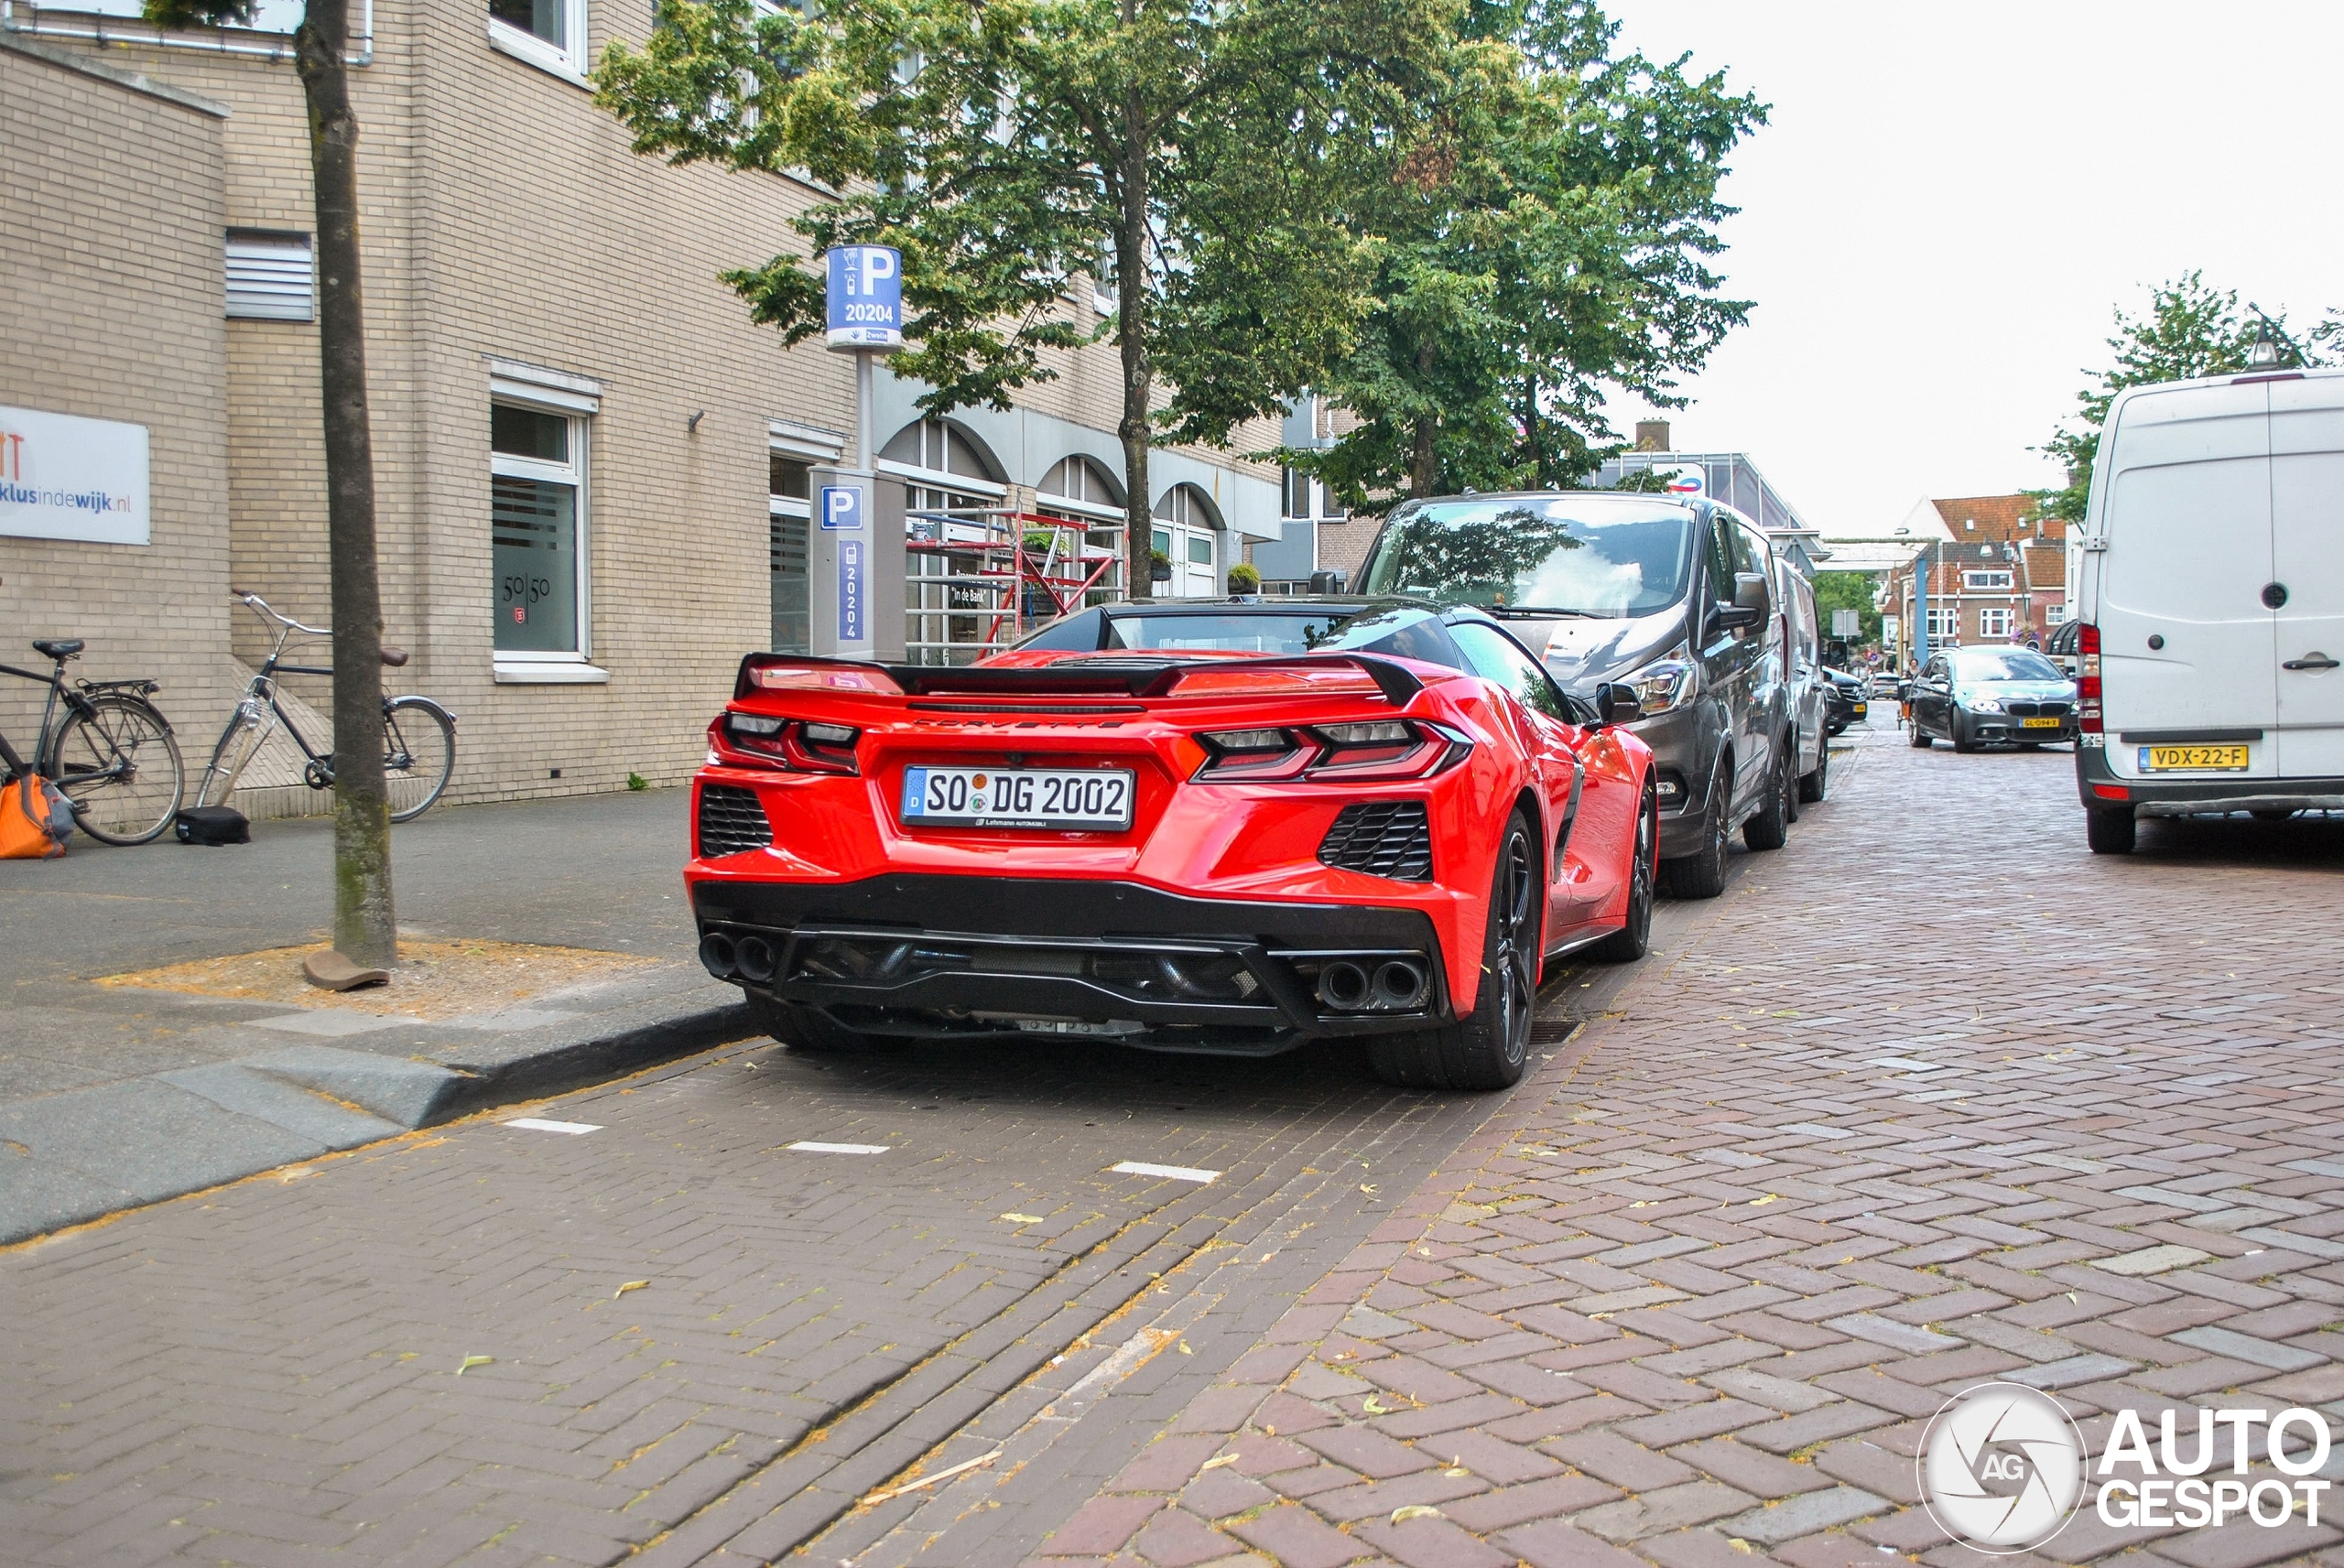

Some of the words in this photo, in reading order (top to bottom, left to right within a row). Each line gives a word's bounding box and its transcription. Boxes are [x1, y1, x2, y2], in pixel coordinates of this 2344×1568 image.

[863, 247, 895, 295] P
[845, 304, 893, 323] 20204
[0, 482, 132, 514] klusindewijk.nl
[829, 491, 854, 523] P
[847, 568, 855, 637] 20204
[961, 588, 969, 601] de
[914, 719, 1124, 729] CORVETTE
[2155, 749, 2241, 765] VDX-22-F
[928, 774, 968, 811] SO
[992, 776, 1034, 813] DG
[1042, 778, 1124, 816] 2002
